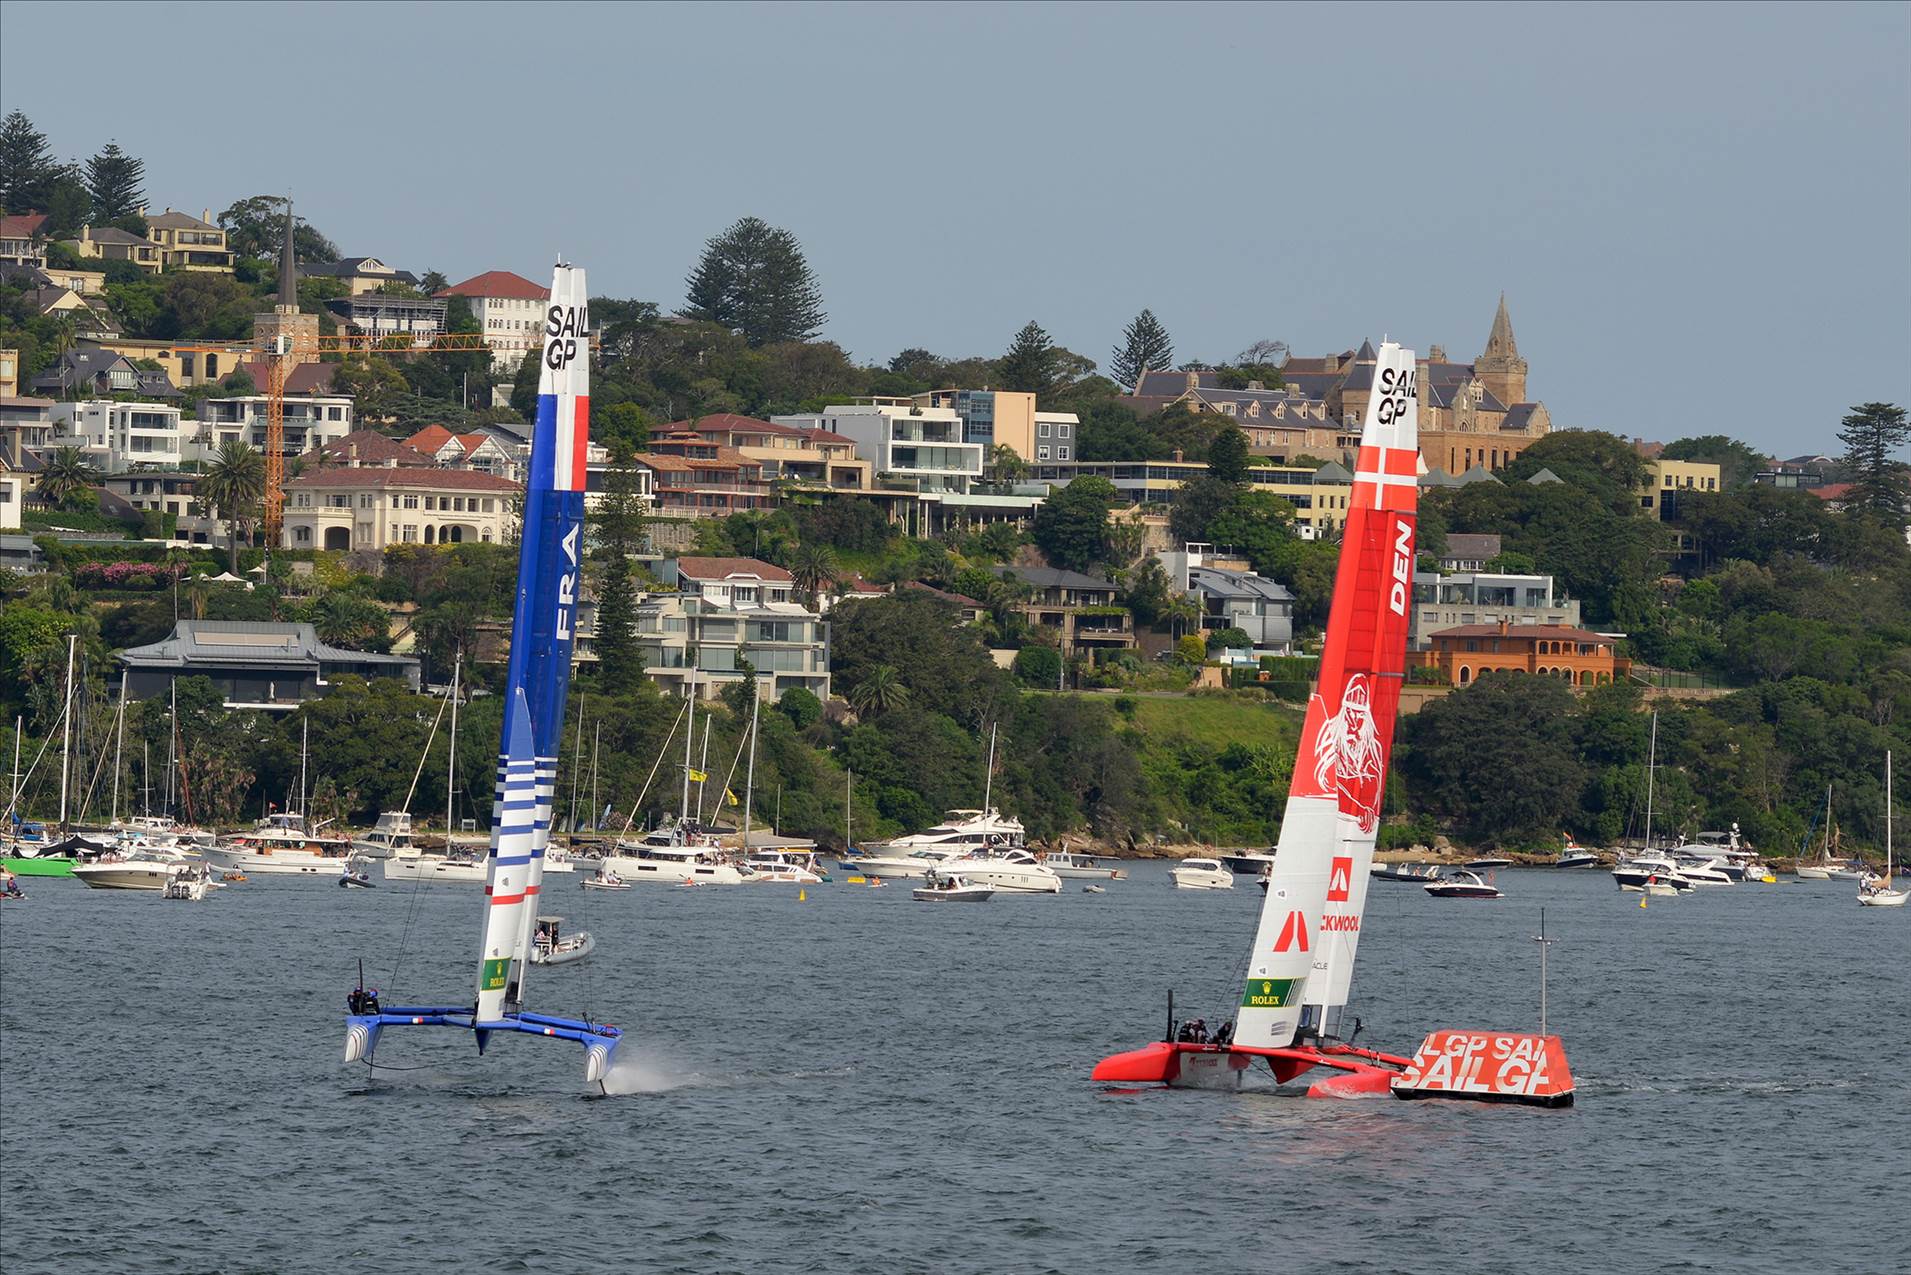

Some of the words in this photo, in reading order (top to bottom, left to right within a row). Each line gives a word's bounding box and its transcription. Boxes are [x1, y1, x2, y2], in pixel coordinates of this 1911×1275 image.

[546, 305, 592, 337] SAIL
[546, 339, 576, 370] GP
[1377, 397, 1407, 425] GP
[556, 522, 579, 640] FRA
[1390, 520, 1412, 616] DEN
[1251, 996, 1279, 1005] ROLEX
[1445, 1035, 1488, 1059] GP
[1391, 1054, 1489, 1092] SAIL
